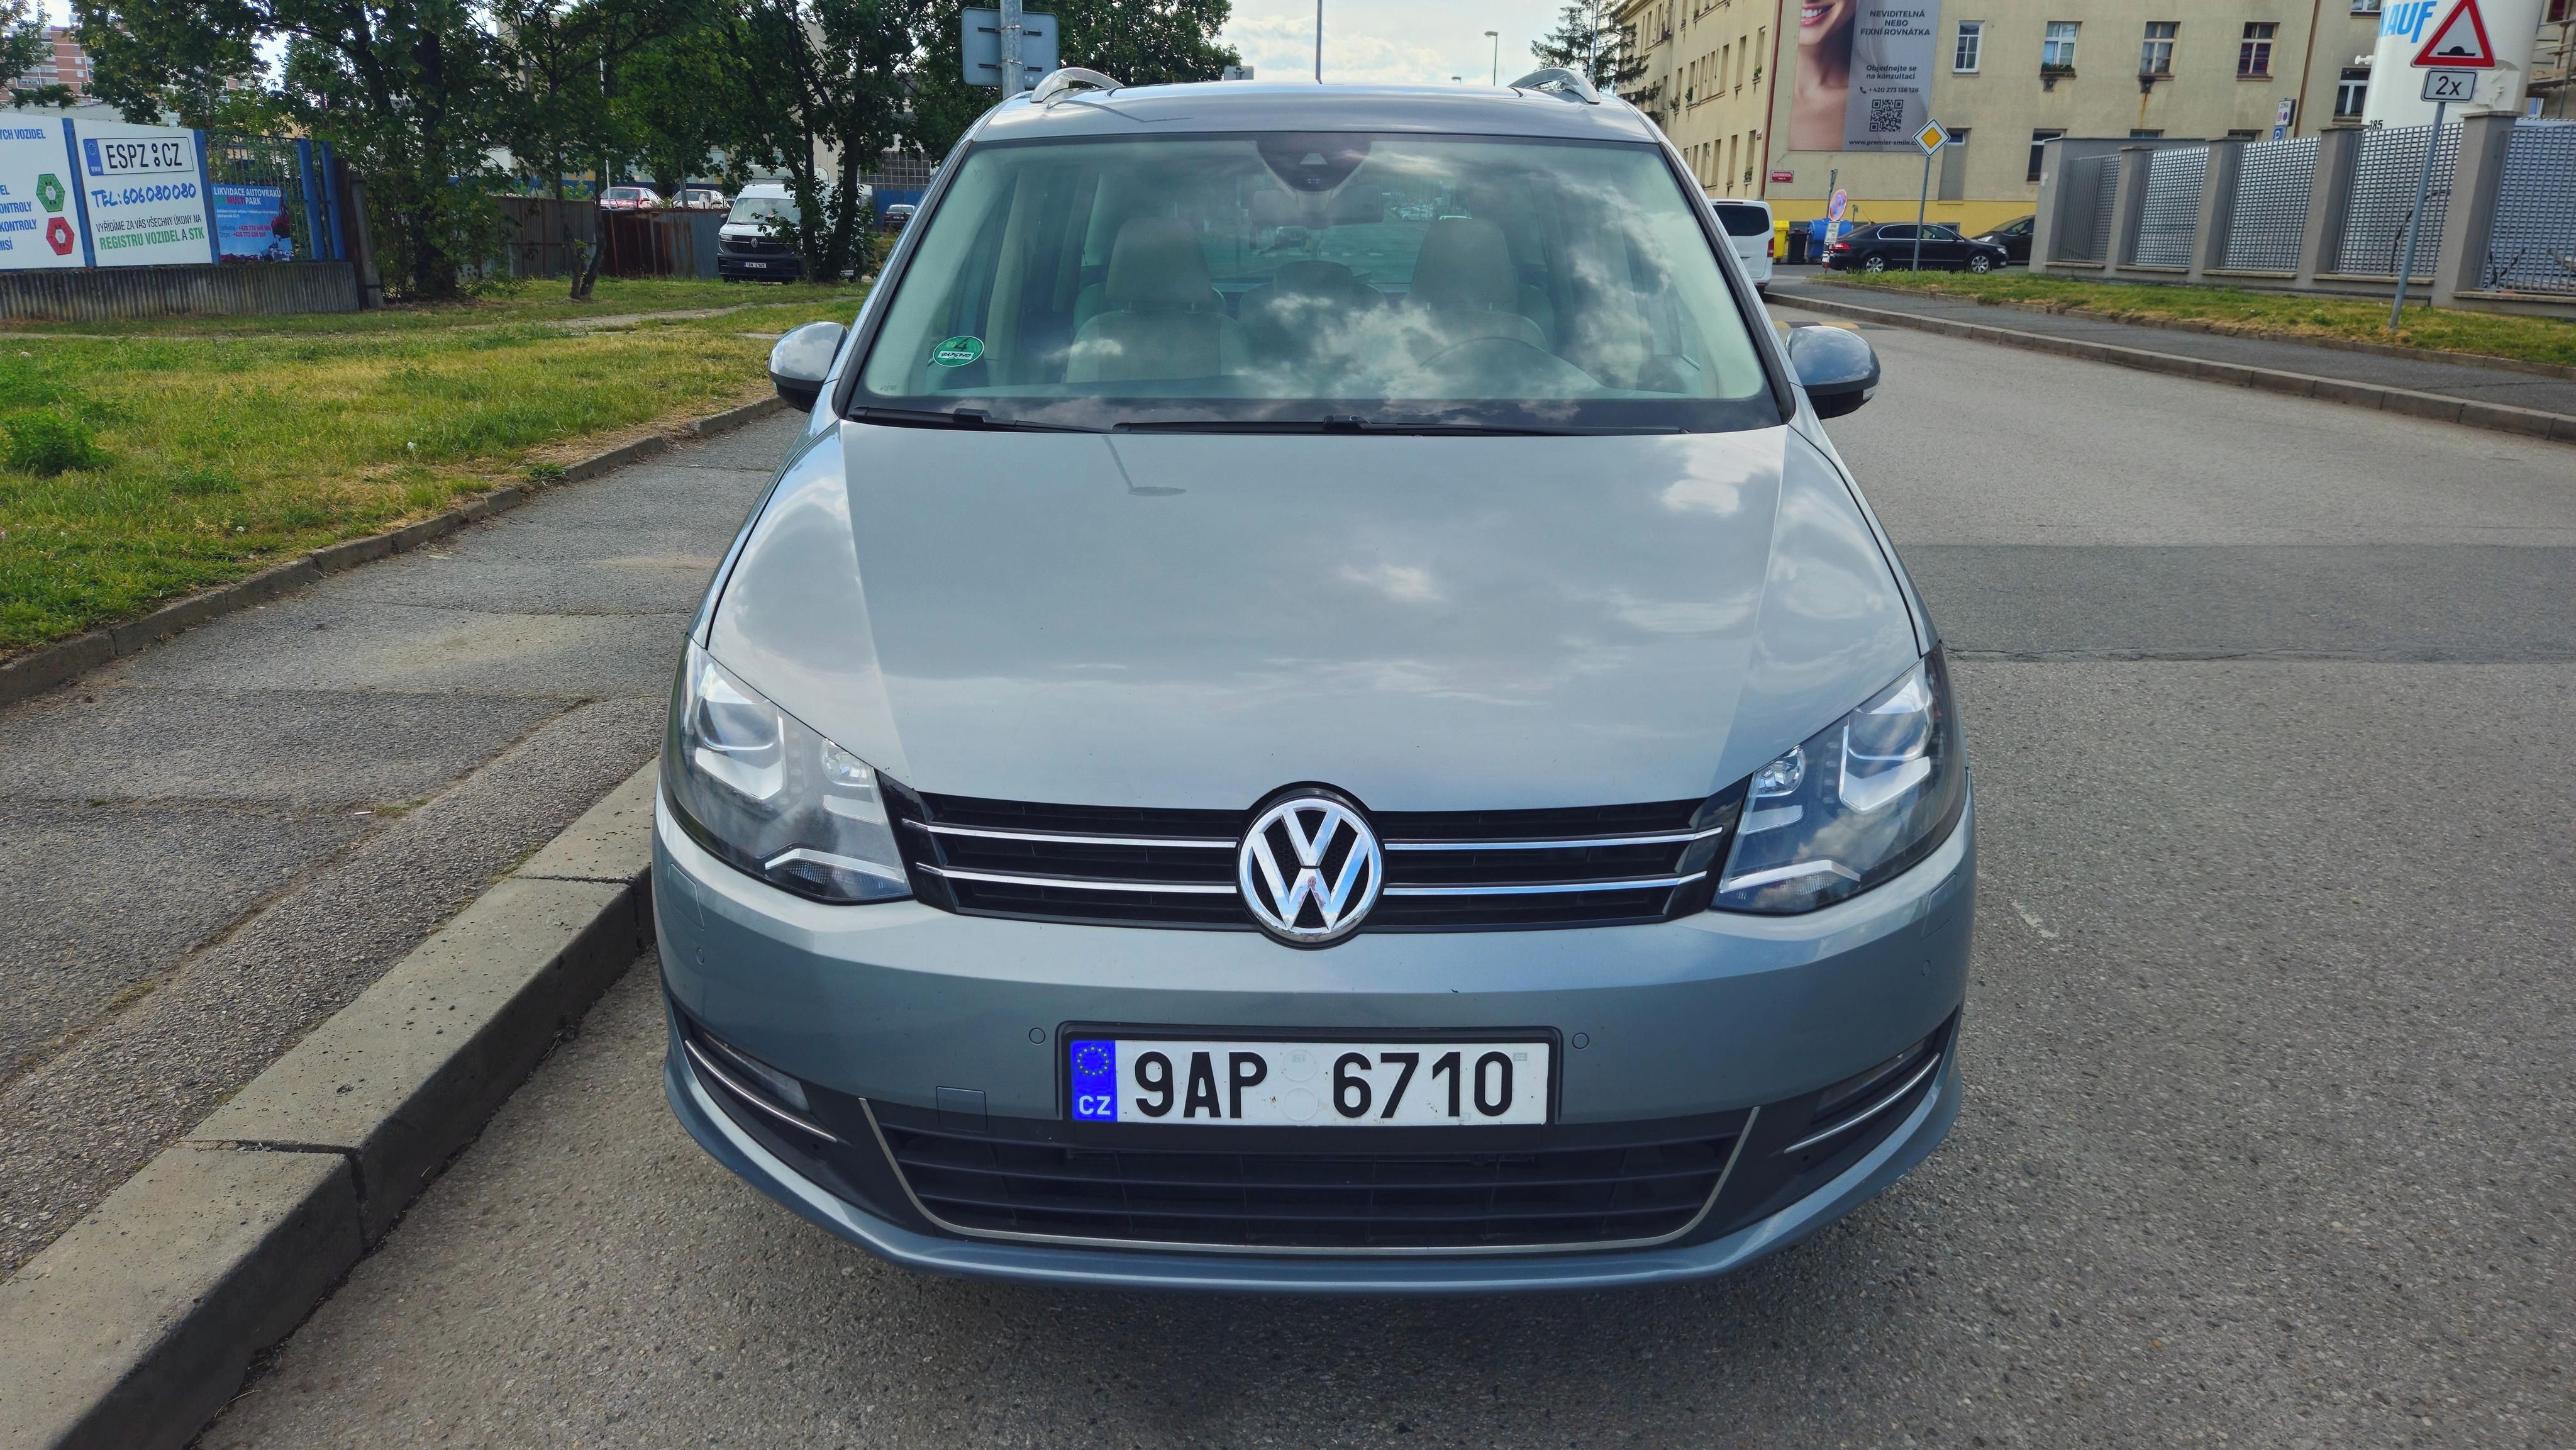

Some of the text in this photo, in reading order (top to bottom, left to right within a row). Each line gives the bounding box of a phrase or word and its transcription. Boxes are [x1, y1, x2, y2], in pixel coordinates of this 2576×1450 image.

[1870, 9, 1925, 18] NEVIDITELNÁ
[1860, 27, 1930, 36] FIXNÍ ROVNÁTKA
[2435, 75, 2462, 96] 2x
[14, 128, 47, 140] VOZIDEL
[106, 143, 182, 169] ESPZ CZ
[214, 187, 281, 198] LIKVIDACE AUTOVRAKŮ
[96, 214, 202, 233] VYŘÍDÍME ZA VÁS VŠECHNY ÚKONY NA
[99, 226, 205, 250] REGISTRU VOZIDEL A STK
[953, 338, 969, 352] 4
[1134, 1051, 1514, 1118] 9AP 6710
[1079, 1095, 1111, 1115] CZ
